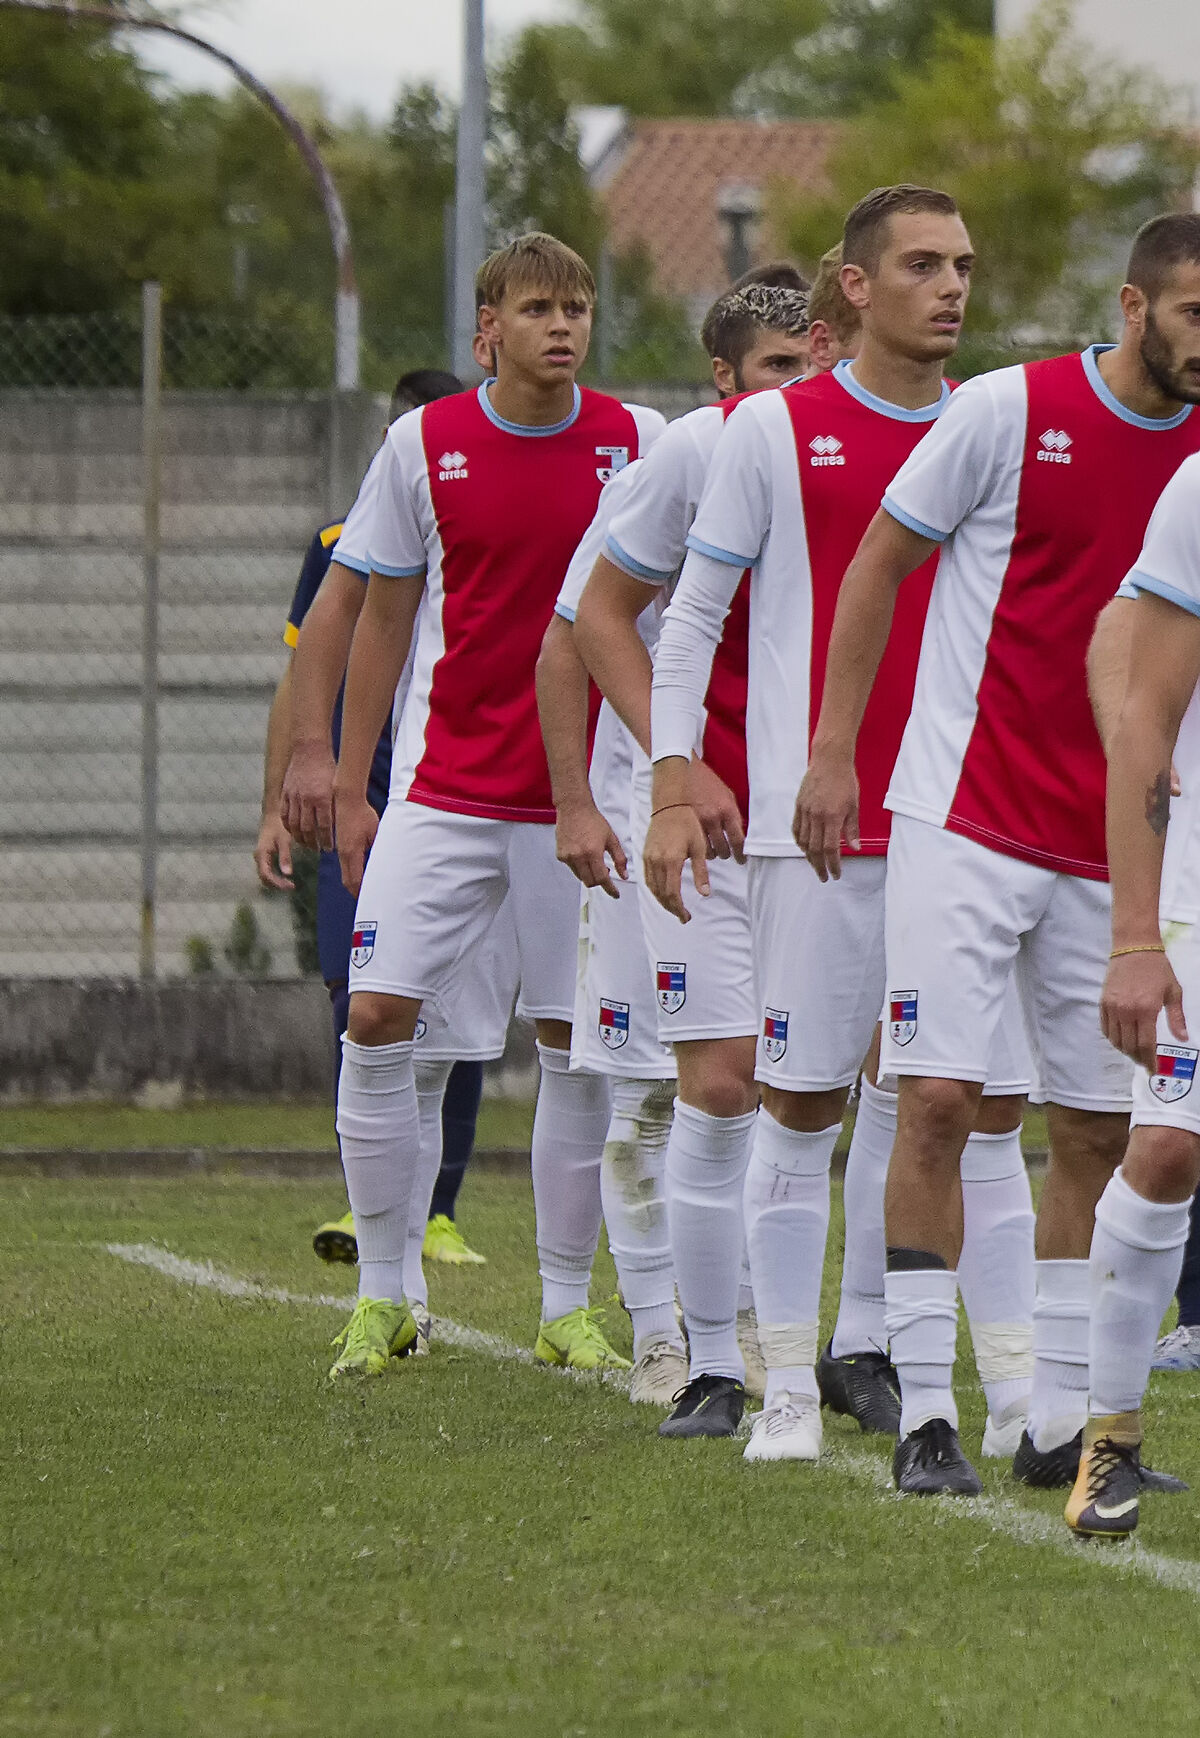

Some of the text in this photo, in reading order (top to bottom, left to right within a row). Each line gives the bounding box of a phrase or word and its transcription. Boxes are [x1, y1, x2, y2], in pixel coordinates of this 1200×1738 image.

[810, 455, 845, 466] errea
[1036, 450, 1072, 464] errea
[1163, 1047, 1190, 1057] UNION
